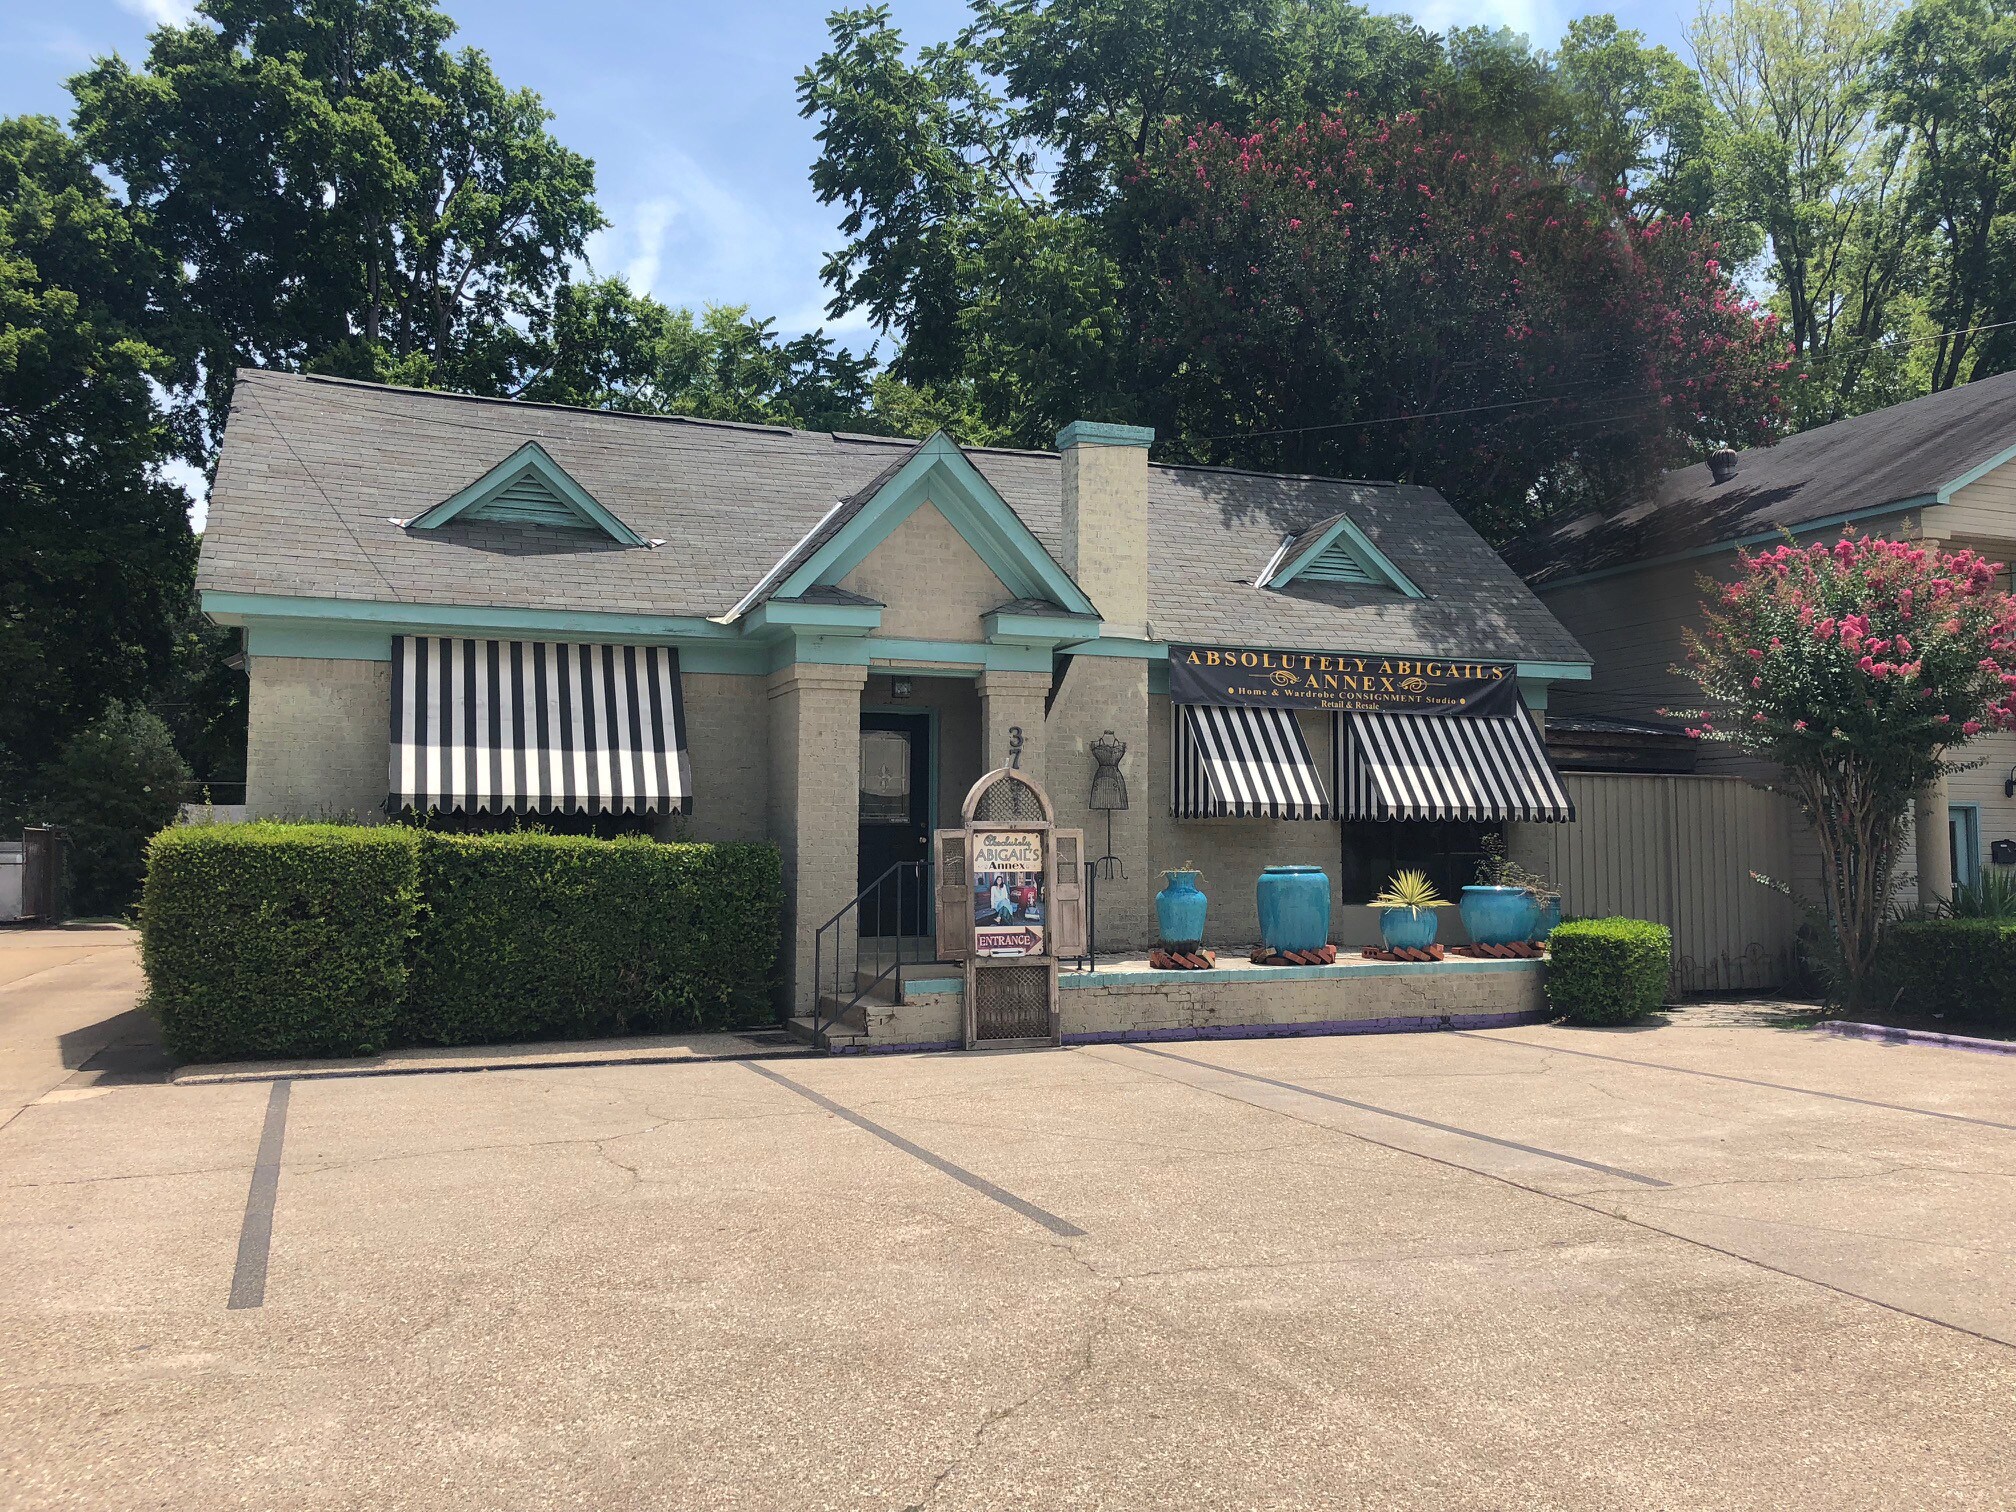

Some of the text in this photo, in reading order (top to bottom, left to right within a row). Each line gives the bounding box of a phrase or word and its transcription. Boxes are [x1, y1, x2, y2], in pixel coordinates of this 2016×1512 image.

[1186, 650, 1504, 680] ABSOLUTELY ABIGAILS
[1304, 674, 1394, 692] ANNEX
[1239, 687, 1457, 705] Home & Wardrobe CONSIGNMENT Studio
[1321, 700, 1344, 709] Retail
[1355, 701, 1380, 710] Resale
[983, 834, 1031, 851] Absolutely
[975, 848, 1040, 862] ABIGAIL'S
[989, 861, 1026, 870] Annex
[979, 934, 1031, 946] ENTRANCE
